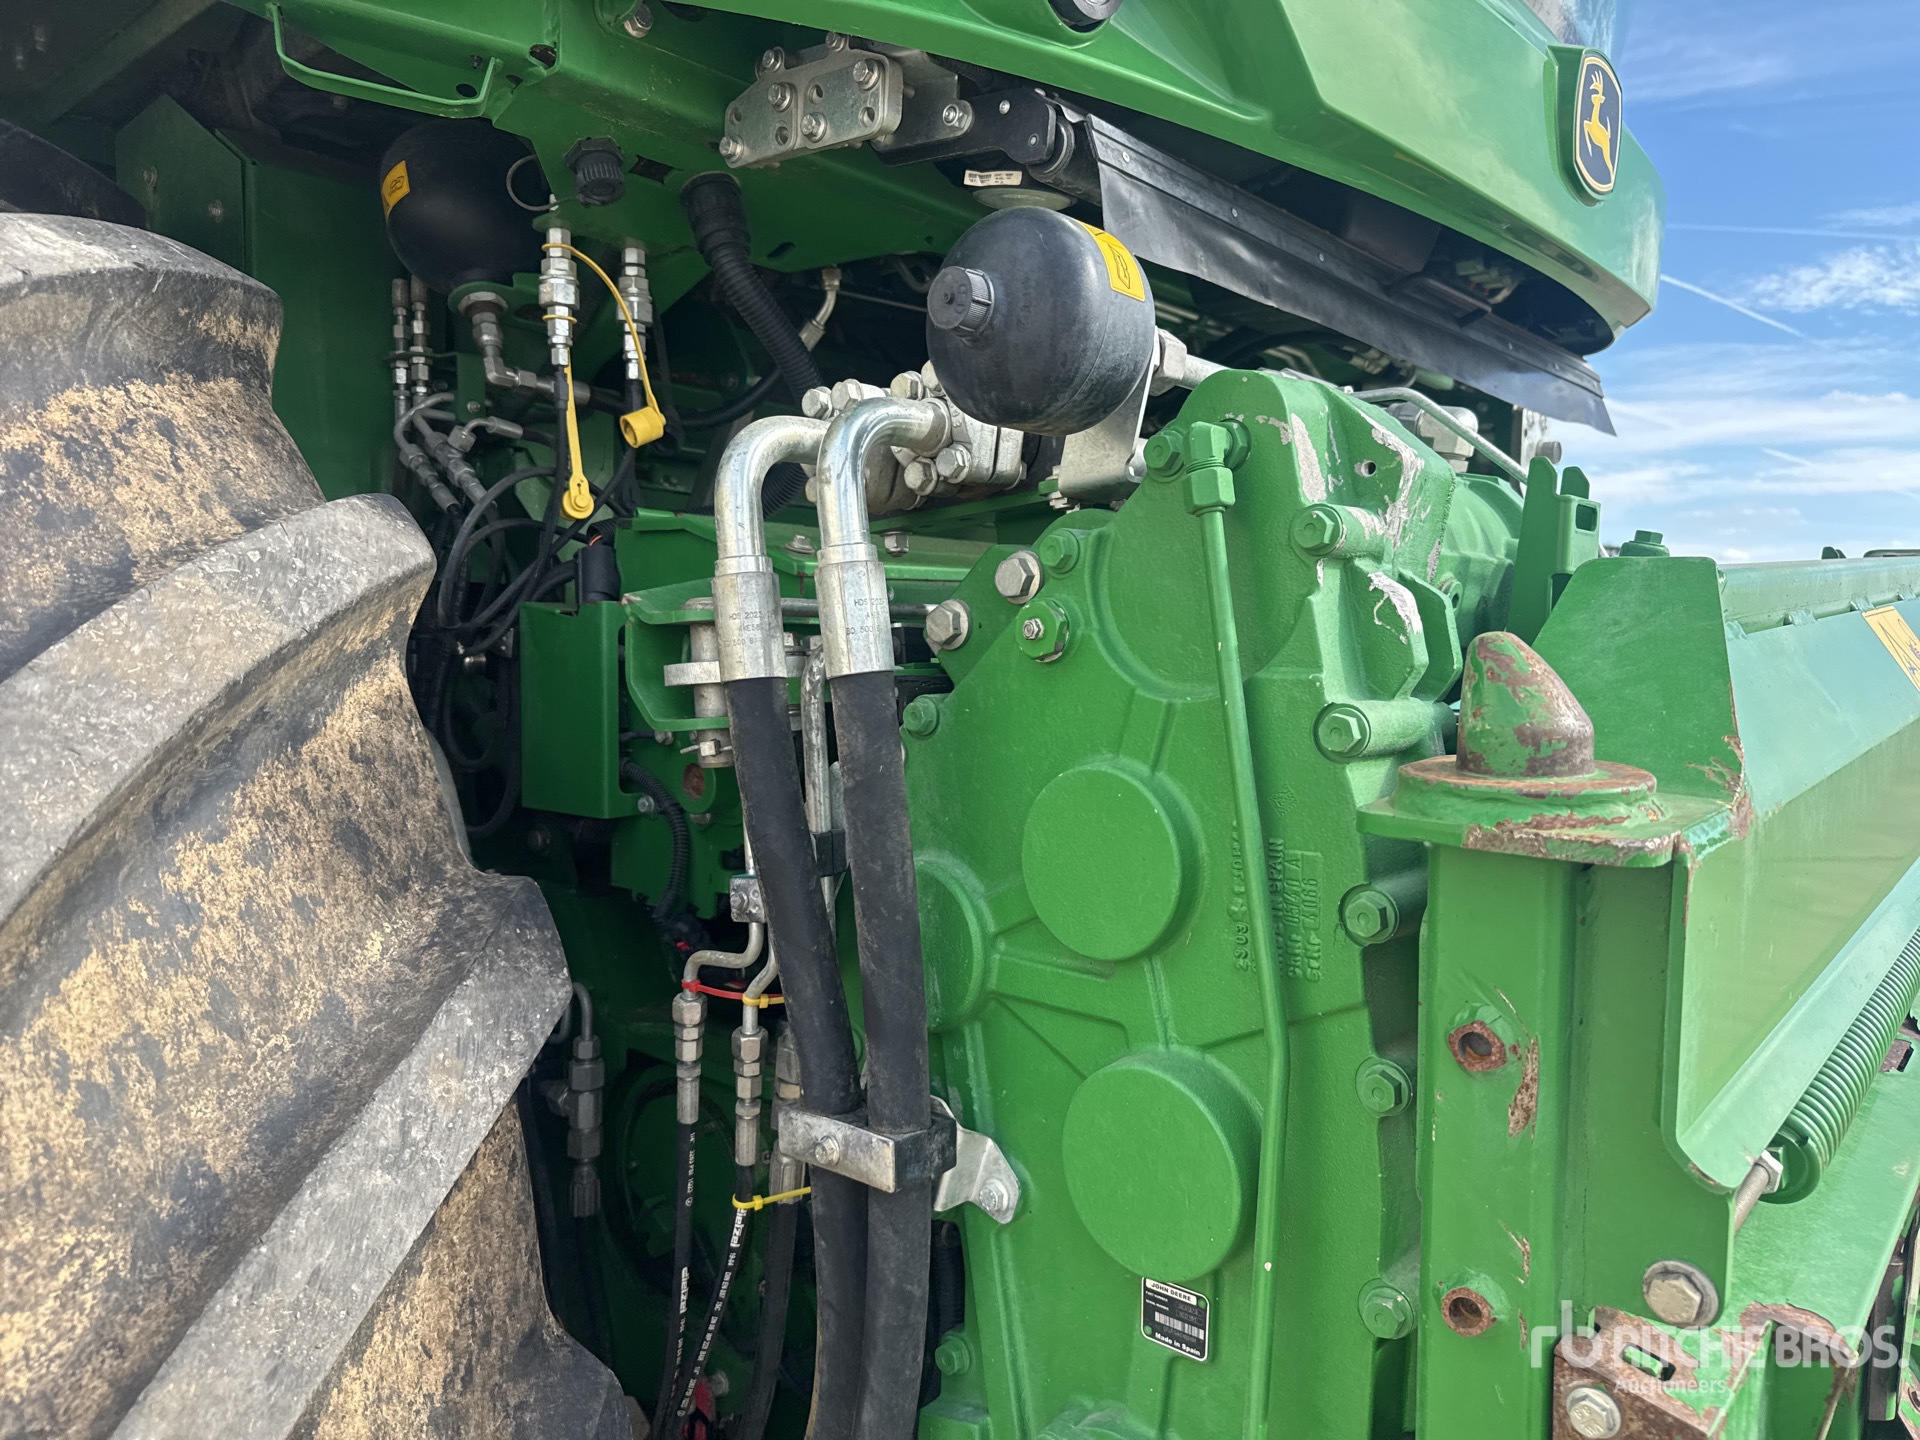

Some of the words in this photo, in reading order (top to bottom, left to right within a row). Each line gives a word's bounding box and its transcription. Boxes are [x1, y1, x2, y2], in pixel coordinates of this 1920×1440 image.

[1269, 838, 1284, 893] SPAIN
[679, 1266, 690, 1314] dietzel
[1151, 1282, 1169, 1293] JOHN
[1170, 1289, 1192, 1302] DEERE
[1155, 1331, 1173, 1345] Made
[1173, 1339, 1181, 1348] in
[1181, 1343, 1201, 1356] Spain
